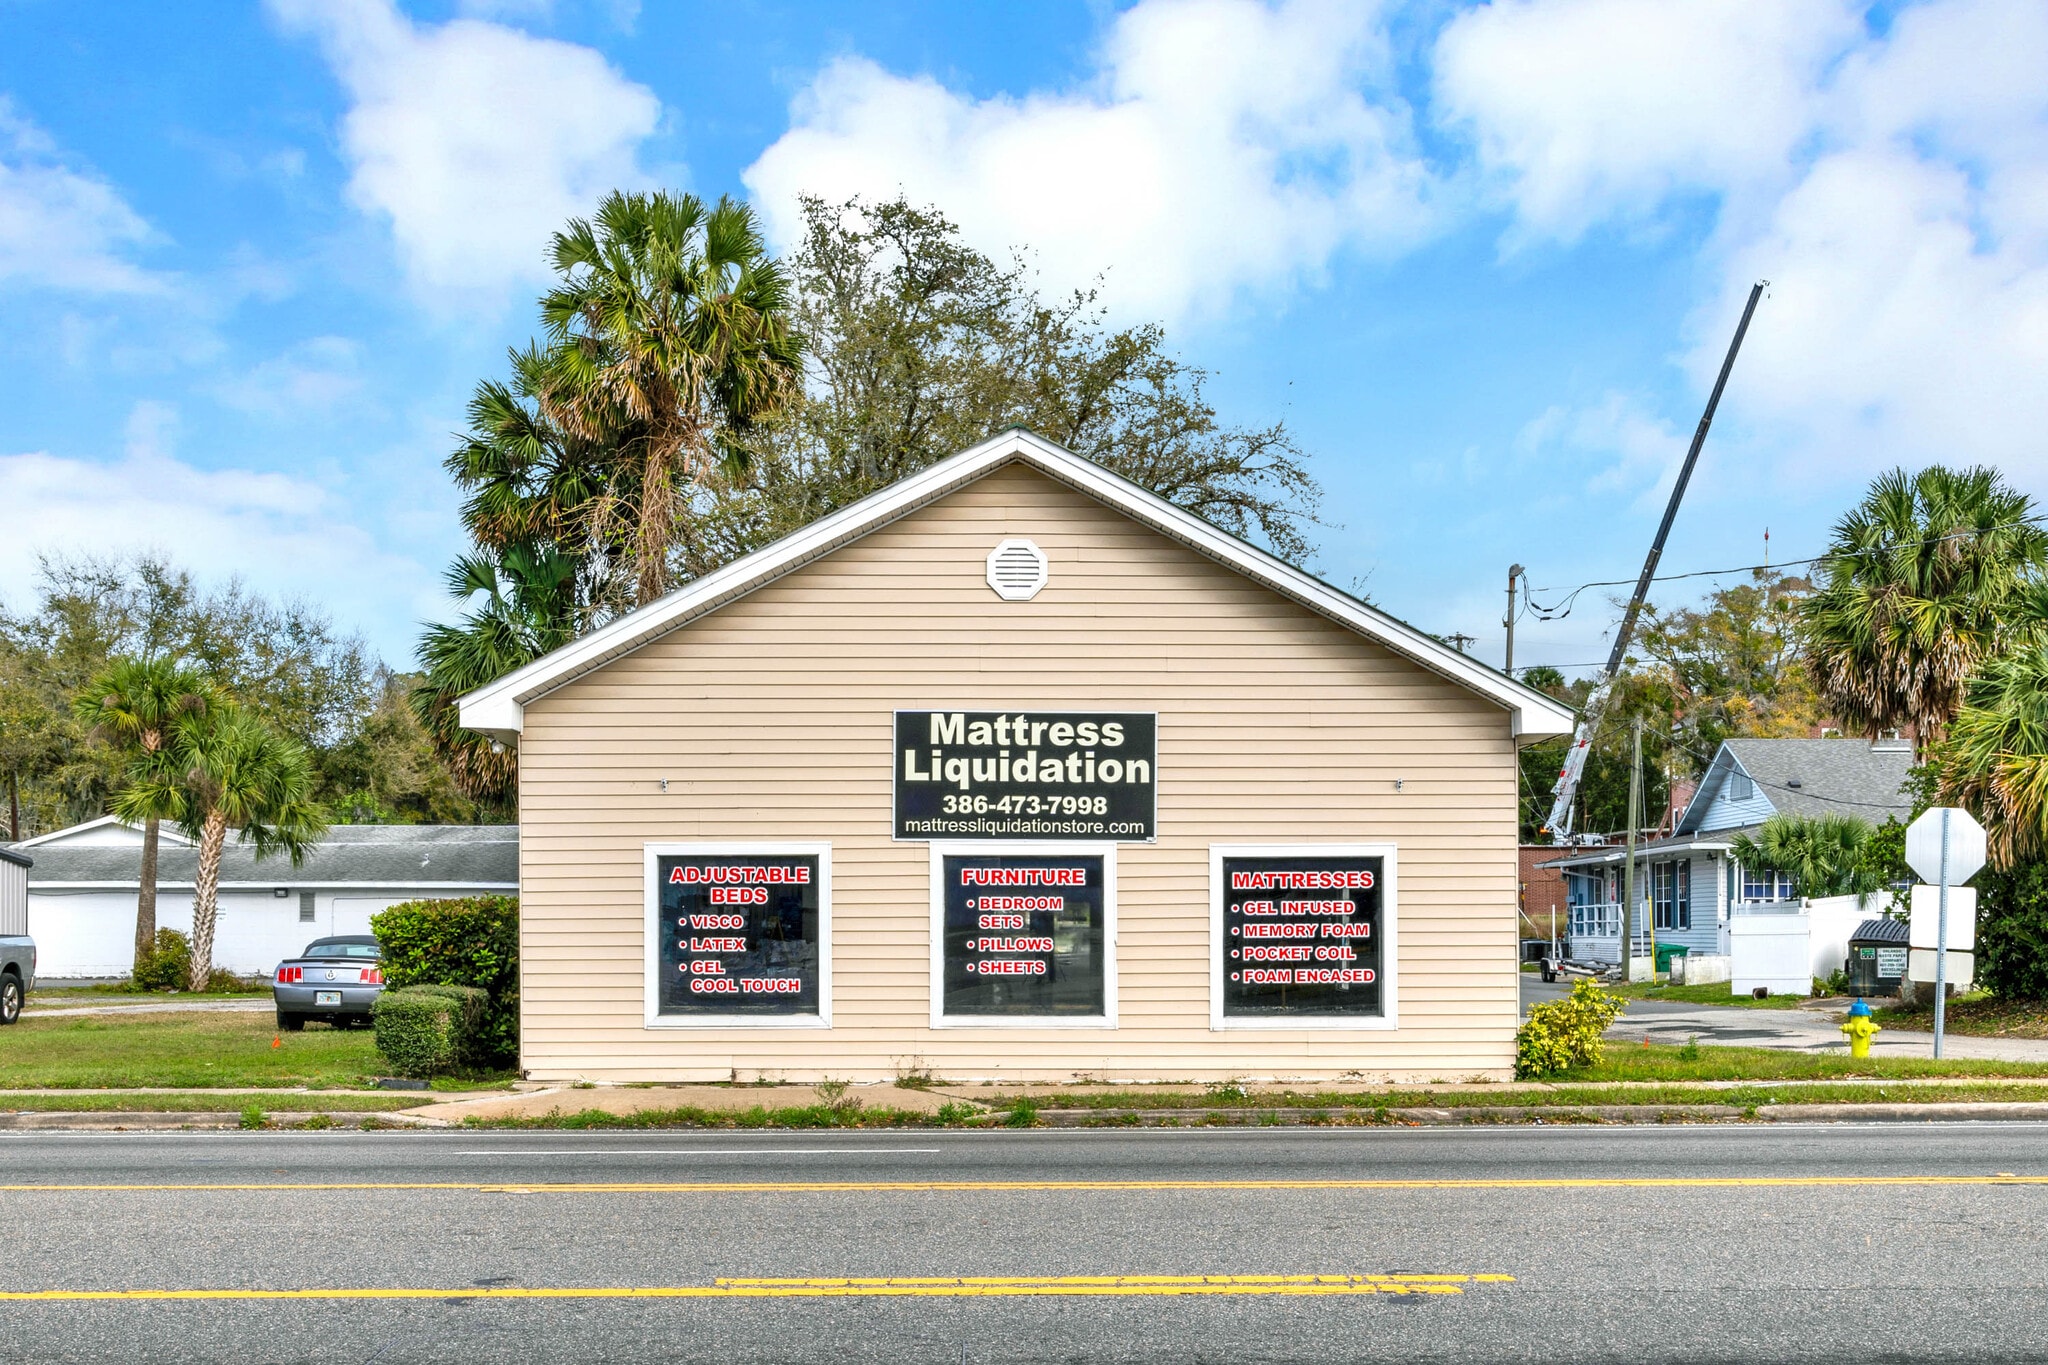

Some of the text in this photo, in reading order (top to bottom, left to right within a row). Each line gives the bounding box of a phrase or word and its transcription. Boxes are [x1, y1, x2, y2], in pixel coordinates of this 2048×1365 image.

[930, 713, 1125, 747] Mattress
[904, 750, 1151, 790] Liquidation
[942, 795, 1108, 815] 386-473-7998
[905, 818, 1145, 836] mattressliquidationstore.com
[670, 867, 809, 883] ADJUSTABLE
[961, 868, 1086, 886] FURNITURE
[1232, 872, 1374, 889] MATTRESSES
[711, 887, 768, 904] BEDS
[979, 897, 1063, 911] BEDROOM
[1243, 901, 1355, 915] GEL INFUSED
[690, 915, 743, 928] VISCO
[979, 915, 1023, 929] SETS
[1243, 923, 1369, 938] MEMORY FOAM
[691, 938, 746, 951] LATEX
[979, 938, 1054, 951] PILLOWS
[1243, 947, 1357, 961] POCKET COIL
[691, 961, 725, 974] GEL
[979, 961, 1046, 974] SHEETS
[1243, 969, 1375, 983] FOAM ENCASED
[691, 979, 800, 992] COOL TOUCH
